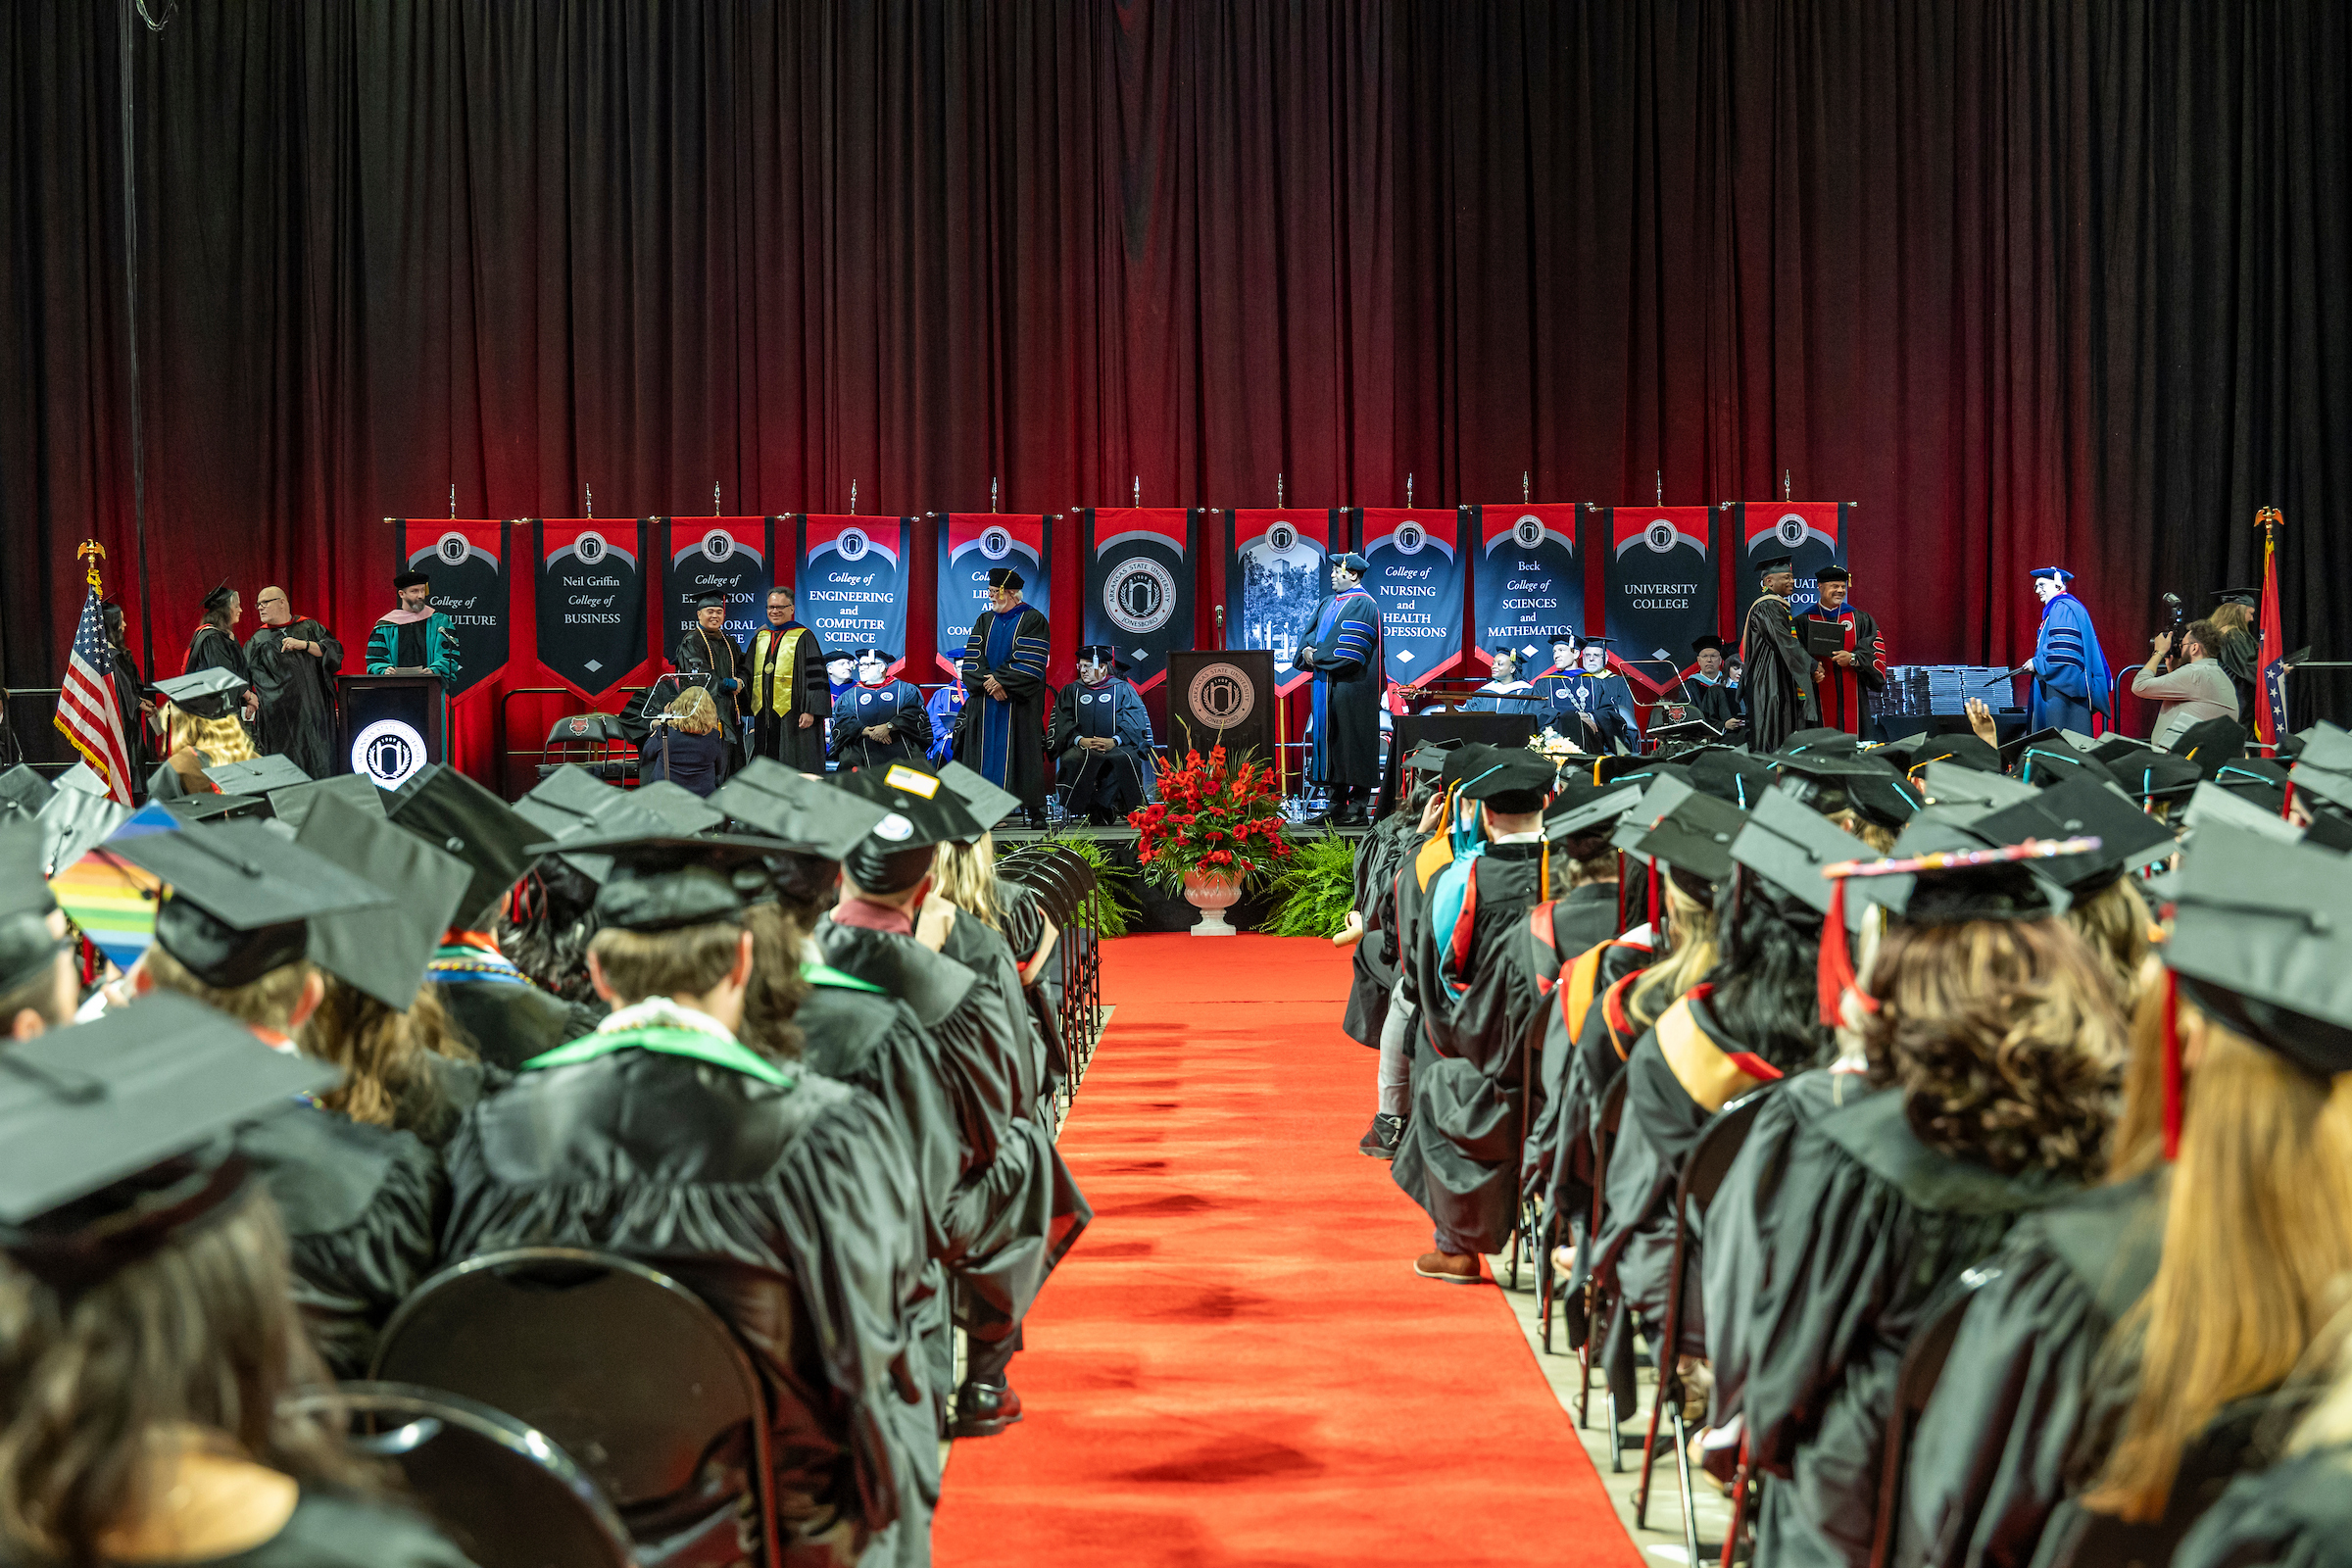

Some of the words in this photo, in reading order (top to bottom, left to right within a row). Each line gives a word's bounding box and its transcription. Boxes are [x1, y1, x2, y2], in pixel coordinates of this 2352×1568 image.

[1518, 561, 1541, 571] Beck
[828, 572, 861, 585] College
[862, 573, 876, 586] of
[1385, 566, 1418, 579] College
[1419, 566, 1432, 580] of
[563, 576, 584, 586] Neil
[586, 576, 620, 586] Griffin
[695, 574, 727, 587] College
[729, 574, 742, 587] of
[1109, 568, 1128, 603] ARKANSAS
[1151, 565, 1171, 603] UNIVERSITY
[1507, 579, 1538, 592] College
[1540, 579, 1552, 592] of
[1380, 585, 1436, 597] NURSING
[1624, 584, 1698, 595] UNIVERSITY
[430, 596, 463, 609] College
[465, 596, 477, 609] of
[568, 595, 602, 608] College
[603, 595, 615, 608] of
[808, 591, 894, 603] ENGINEERING
[840, 605, 858, 615] and
[1396, 600, 1415, 610] and
[1502, 598, 1557, 610] SCIENCES
[1632, 599, 1690, 610] COLLEGE
[450, 614, 497, 625] ULTURE
[564, 613, 621, 624] BUSINESS
[1121, 616, 1158, 627] JONESBORO
[1383, 612, 1431, 623] HEALTH
[1520, 612, 1537, 622] and
[815, 617, 885, 630] COMPUTER
[824, 631, 876, 643] SCIENCE
[1383, 626, 1446, 638] OFESSIONS
[1488, 625, 1573, 637] MATHEMATICS
[1193, 672, 1209, 703] ARKANSAS
[1230, 670, 1250, 702] UNIVERSITY
